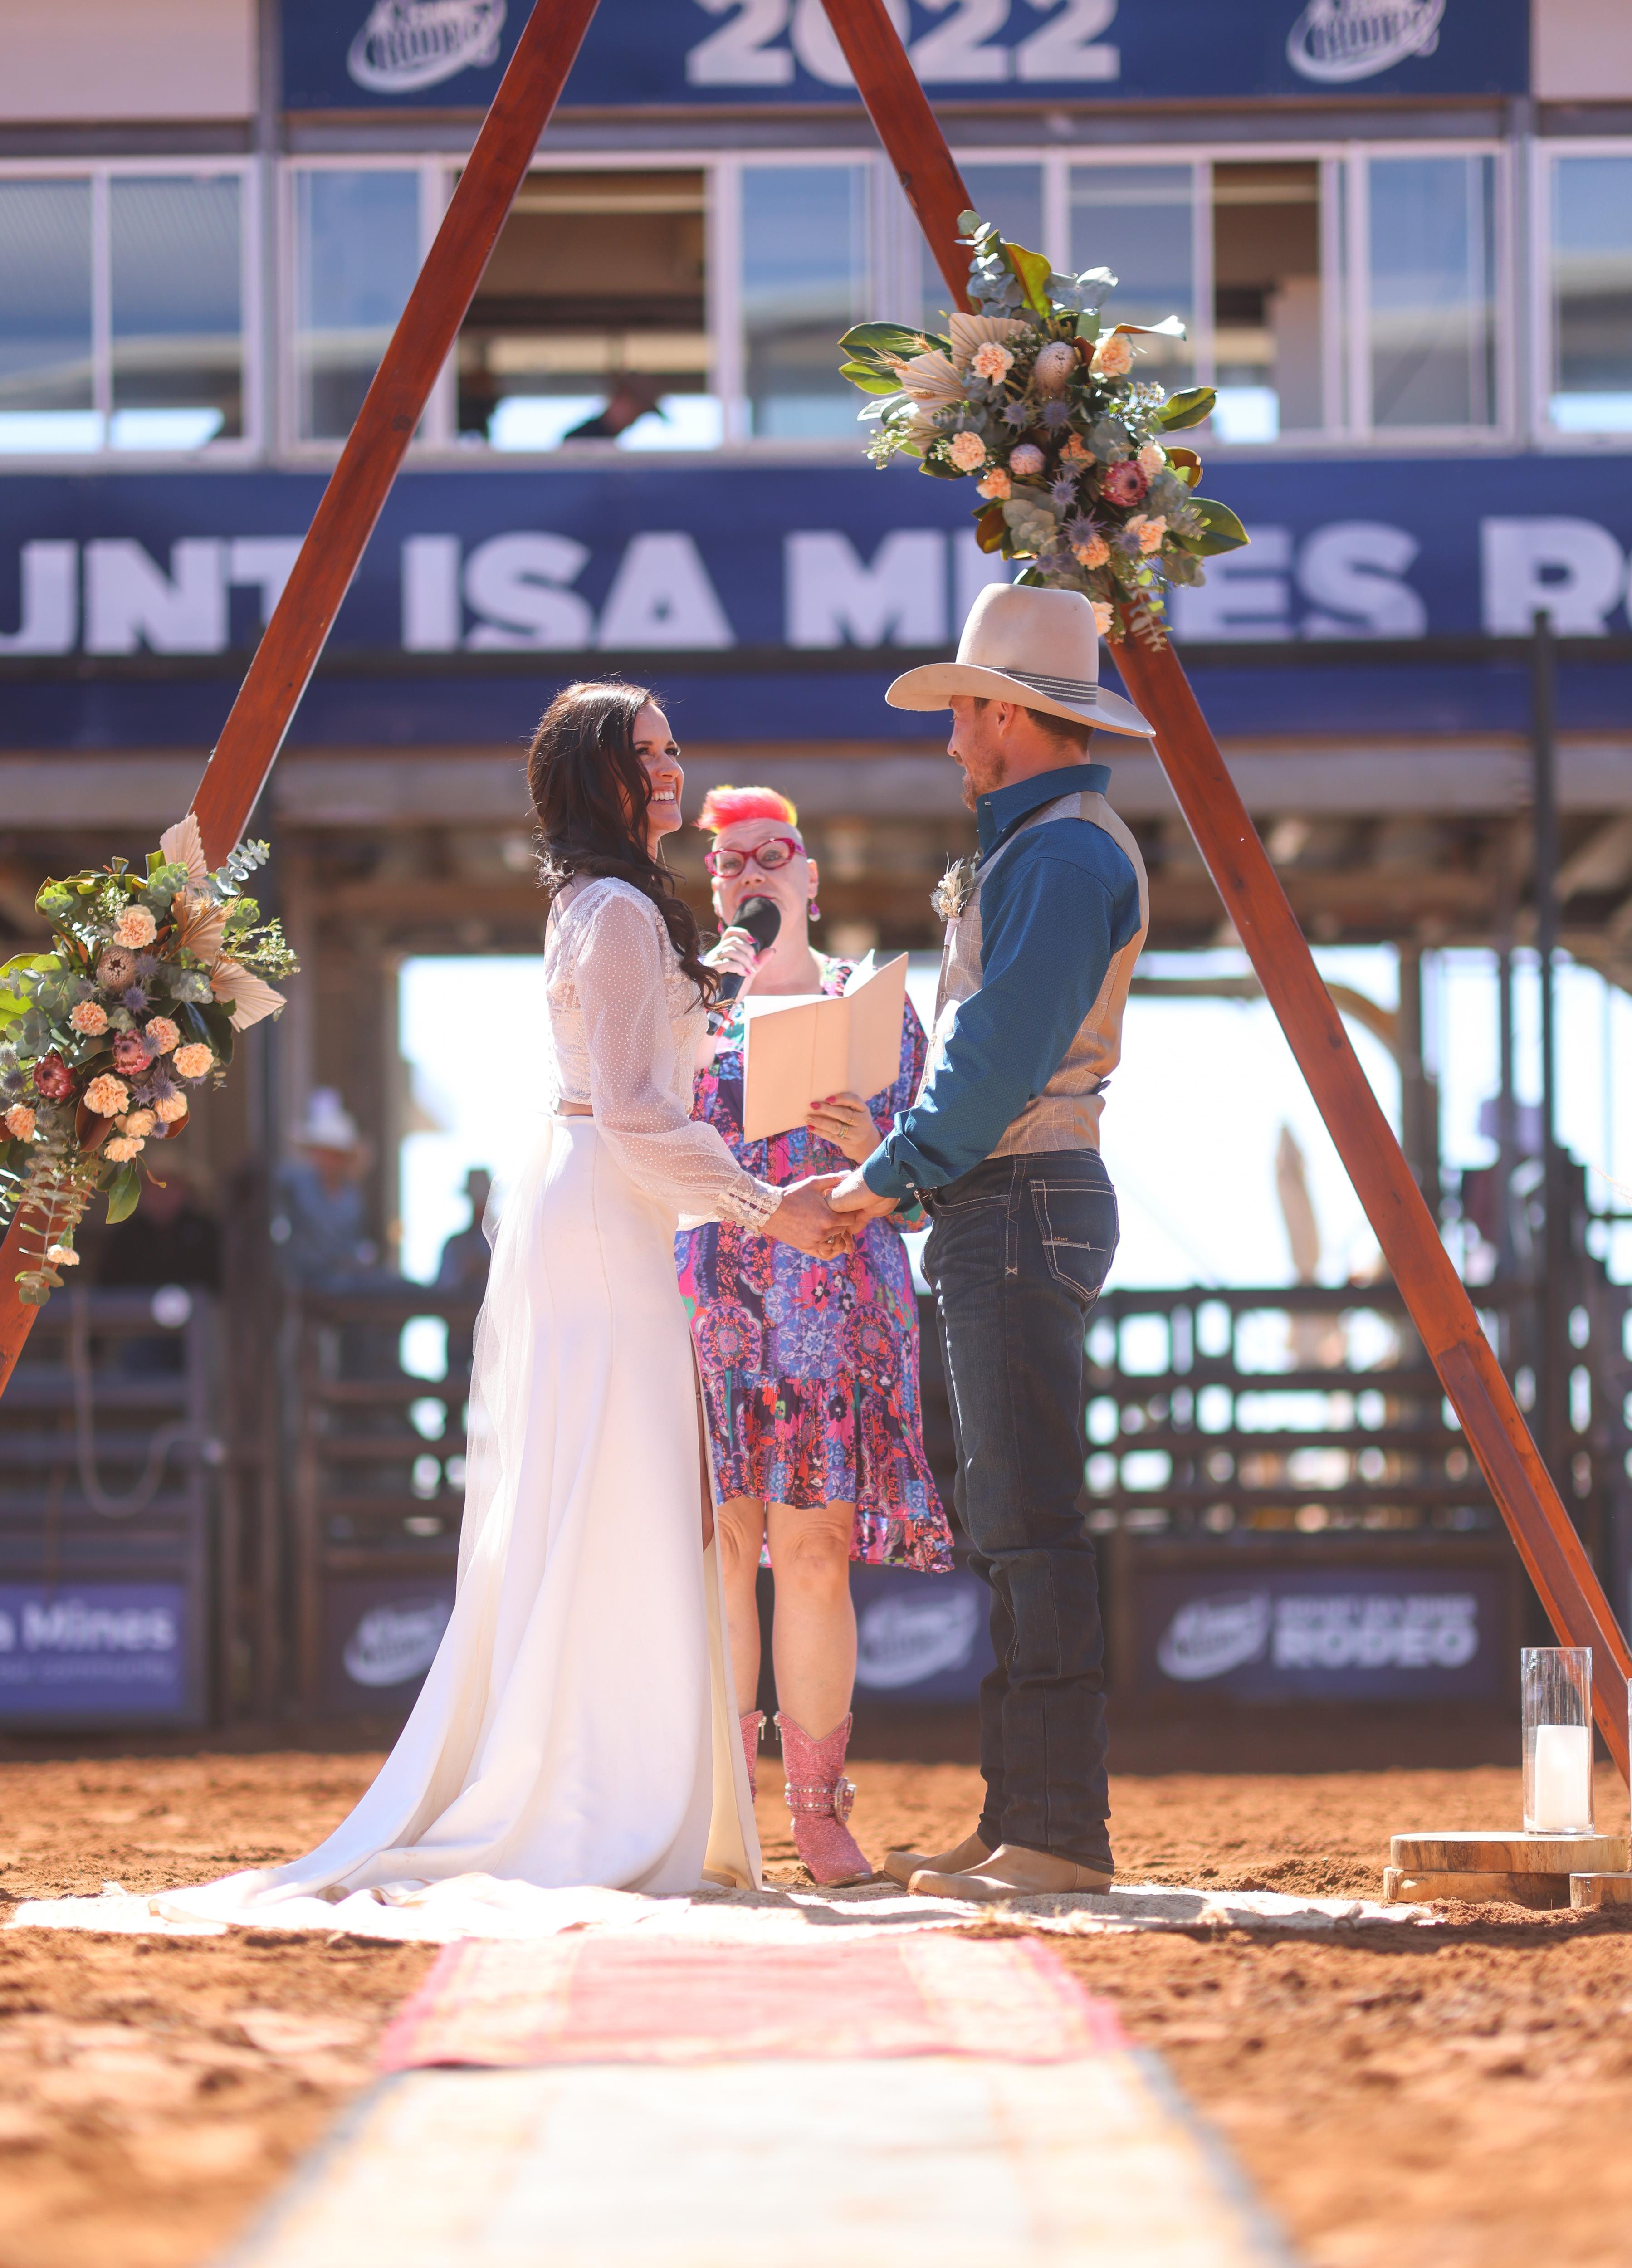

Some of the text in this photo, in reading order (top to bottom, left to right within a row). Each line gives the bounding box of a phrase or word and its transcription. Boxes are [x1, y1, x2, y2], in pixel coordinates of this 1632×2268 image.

[401, 530, 736, 652] ISA
[785, 521, 1425, 650] MIES
[1480, 515, 1632, 638] R
[22, 1601, 175, 1652] Mines
